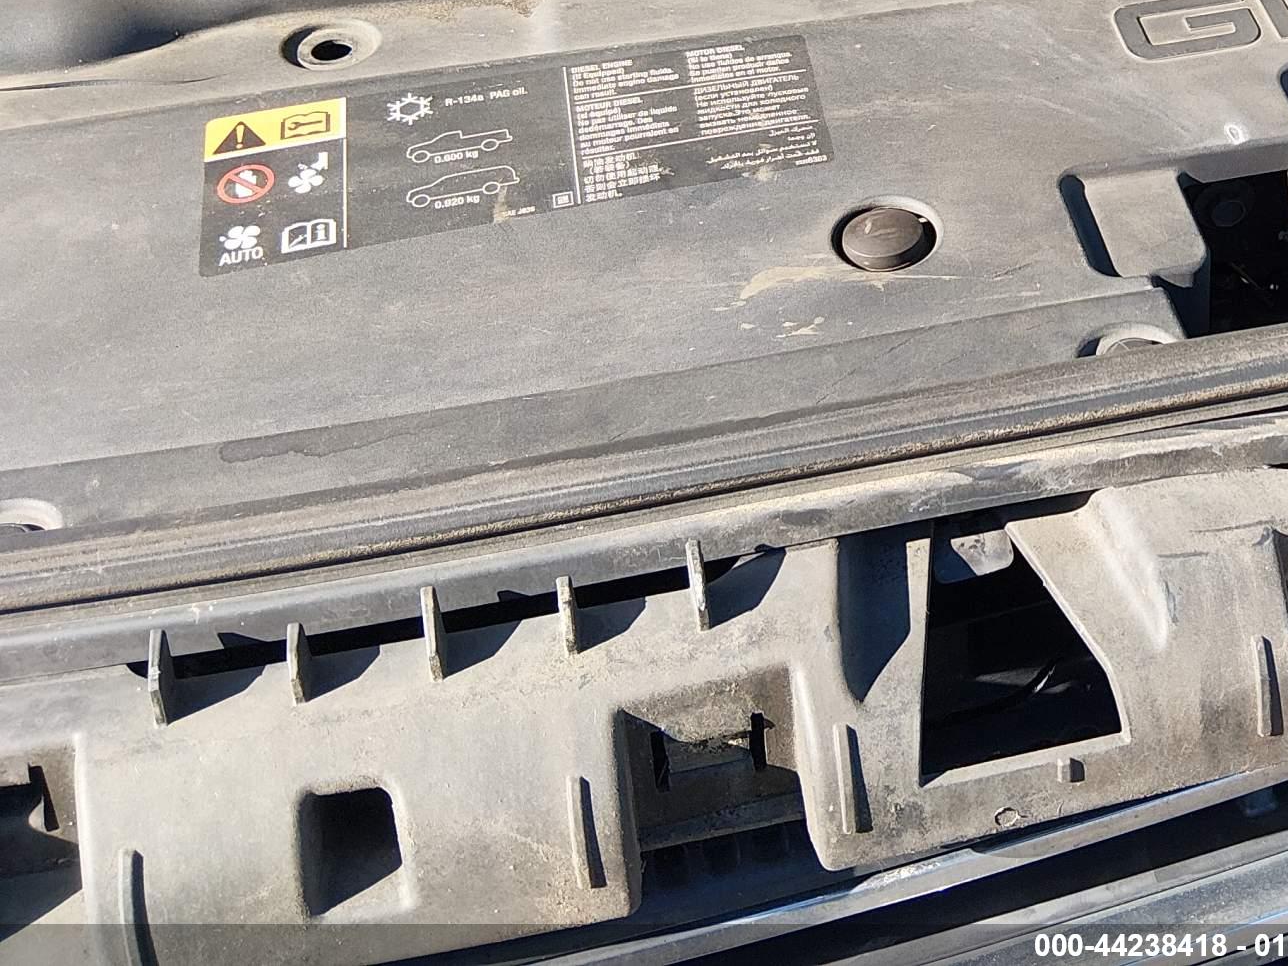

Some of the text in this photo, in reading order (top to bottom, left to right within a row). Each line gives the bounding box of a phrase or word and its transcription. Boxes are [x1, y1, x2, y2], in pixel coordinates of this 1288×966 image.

[685, 44, 744, 57] MOTOR DIESEL
[571, 59, 633, 73] DIESEL ENGINE
[617, 70, 648, 80] starting
[617, 78, 645, 87] engine
[646, 73, 679, 83] damage
[693, 73, 799, 95] ДИЗЕЛЬНЫЙ ДВИГАТЕЛЬ
[445, 93, 484, 106] R-134a
[490, 89, 510, 100] PAG
[576, 96, 643, 111] MOTEUR DIESEL
[591, 116, 605, 124] pas
[650, 105, 677, 115] liquide
[636, 116, 652, 124] Des
[579, 128, 625, 141] dommages
[592, 135, 622, 146] moteur
[466, 150, 478, 158] kg
[466, 195, 480, 204] kg
[218, 246, 264, 266] AUTO
